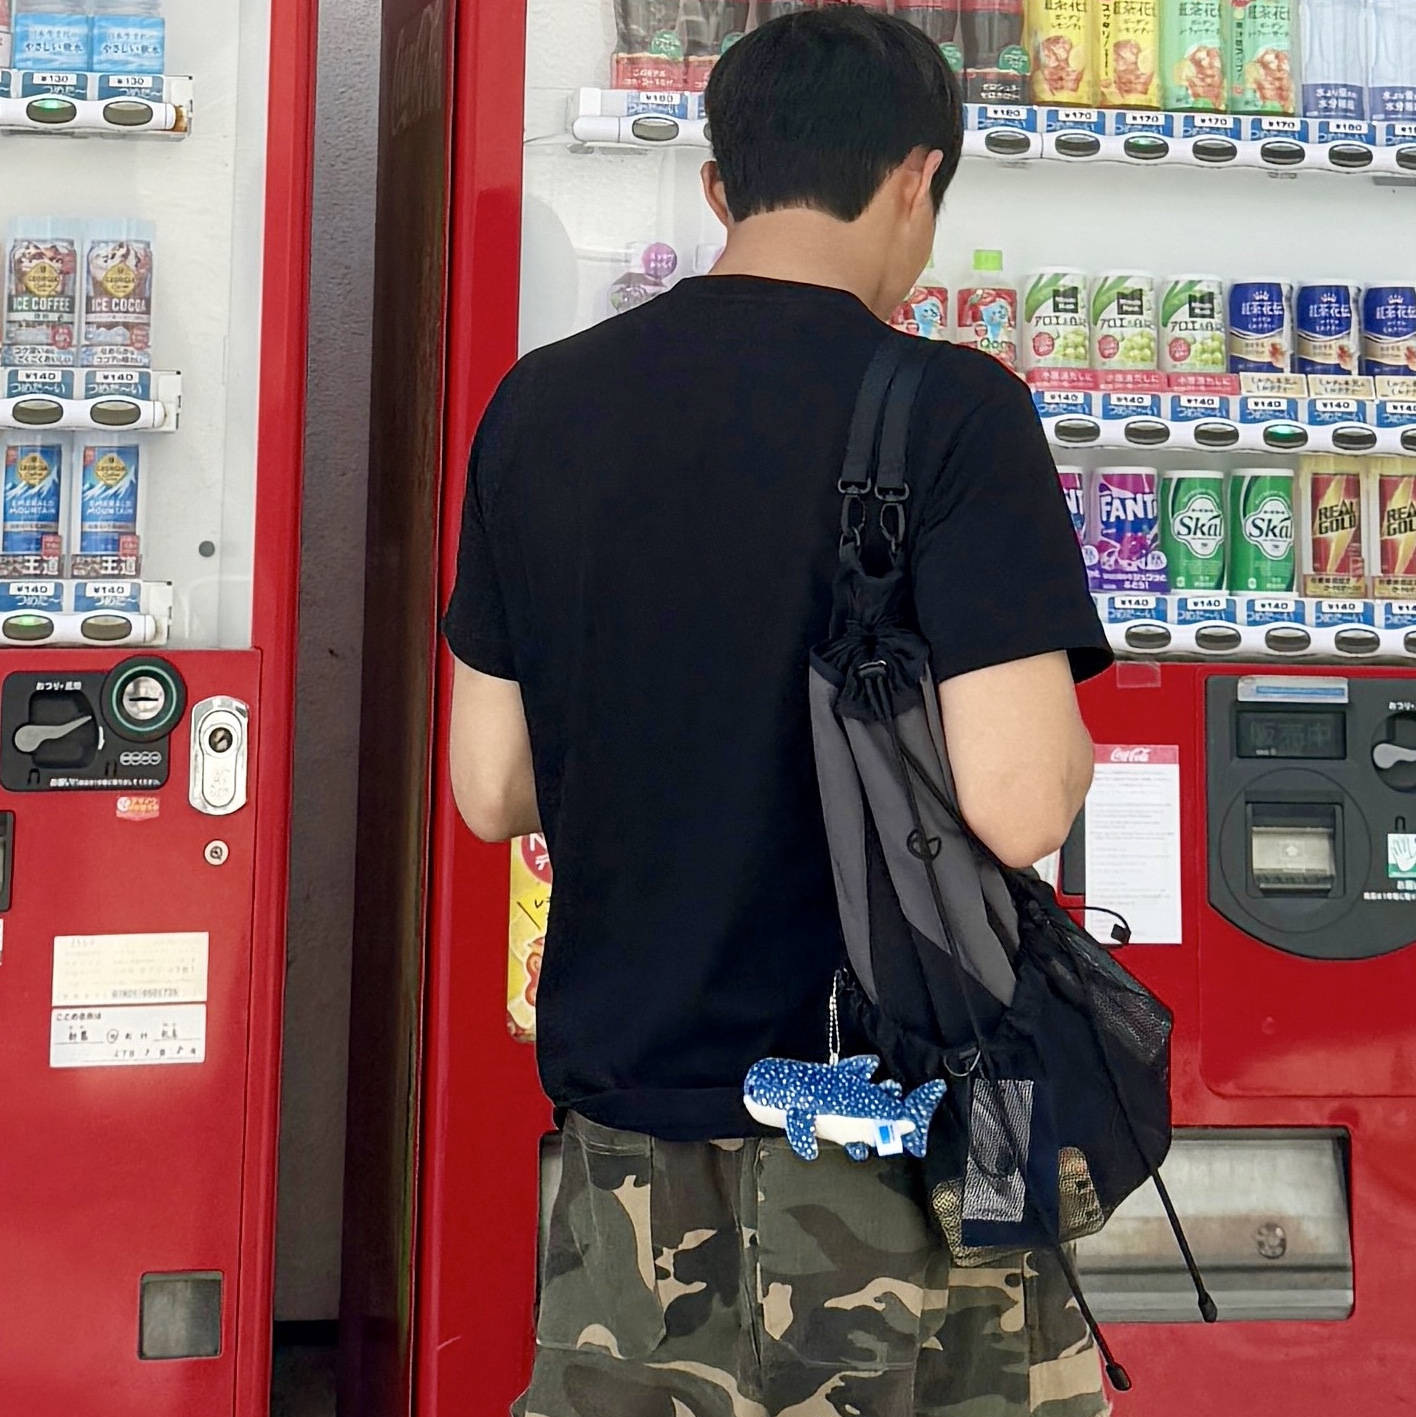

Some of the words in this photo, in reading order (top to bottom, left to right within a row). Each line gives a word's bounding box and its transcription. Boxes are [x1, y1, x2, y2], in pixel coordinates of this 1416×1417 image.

[13, 298, 29, 310] ICE
[32, 298, 70, 311] COFFEE
[92, 298, 108, 311] ICE
[112, 299, 146, 311] COCOA
[1318, 501, 1354, 520] REAL
[1319, 514, 1355, 535] GOLD
[24, 556, 58, 575] 王道
[102, 556, 136, 575] 王道
